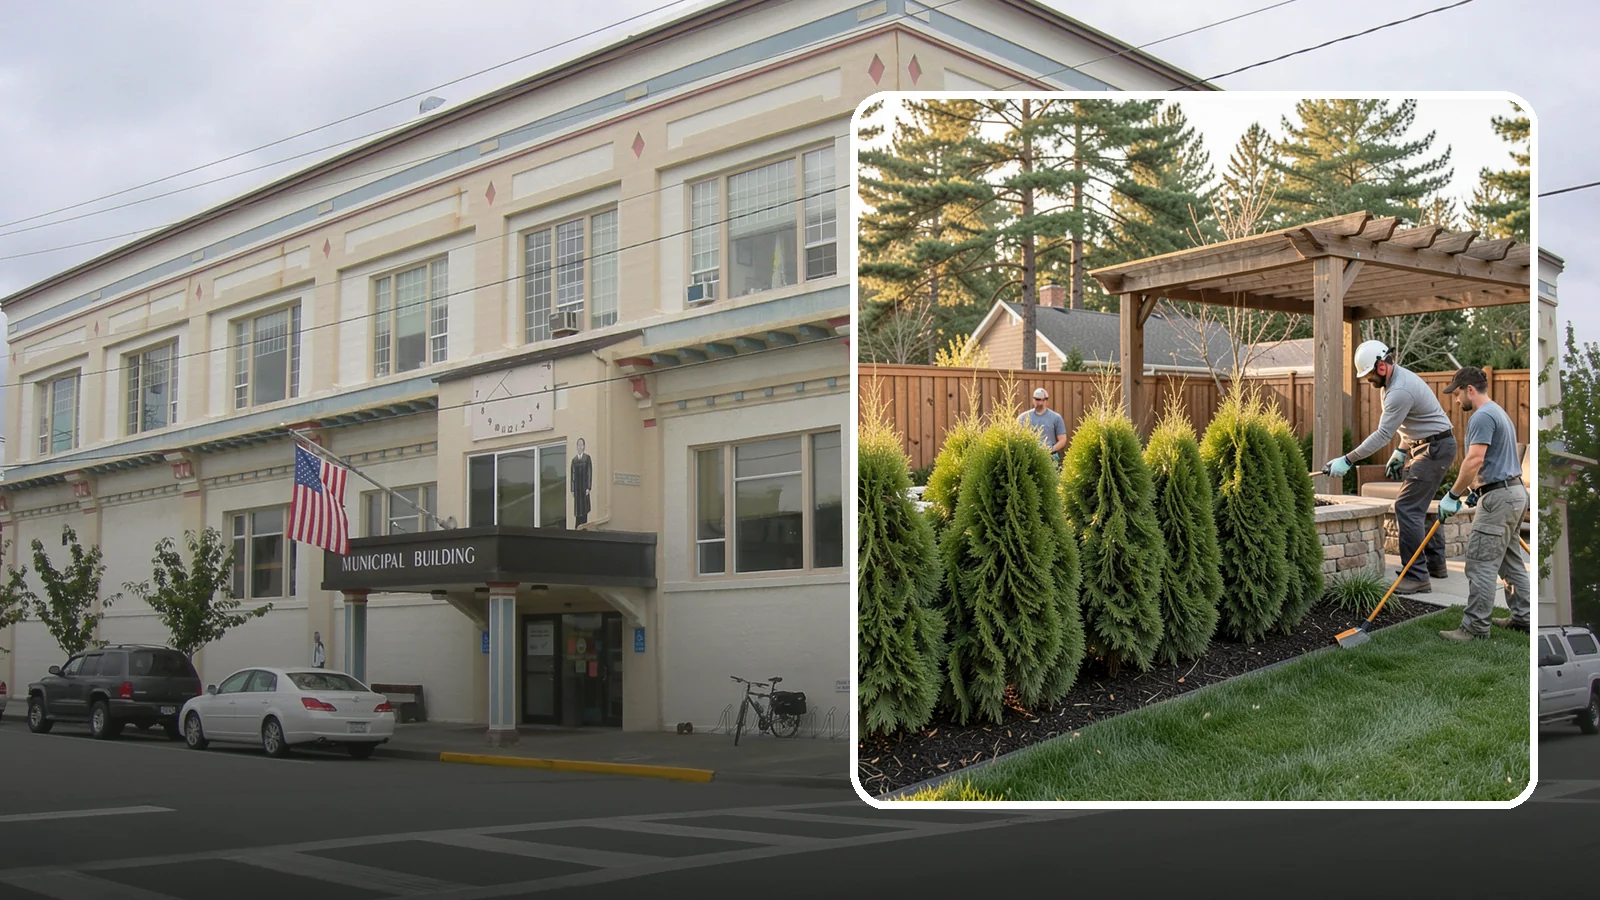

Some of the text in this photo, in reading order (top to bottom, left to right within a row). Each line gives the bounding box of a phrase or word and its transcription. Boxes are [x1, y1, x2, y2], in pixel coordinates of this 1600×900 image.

[546, 361, 552, 370] 6
[475, 390, 480, 398] 7
[536, 402, 540, 410] 4
[481, 407, 485, 415] 8
[488, 417, 492, 426] 9
[529, 414, 533, 422] 3
[494, 423, 500, 432] 10
[521, 420, 525, 428] 2
[501, 425, 506, 434] 11
[507, 425, 513, 433] 12
[342, 546, 475, 572] MUNICIPAL BUILDING
